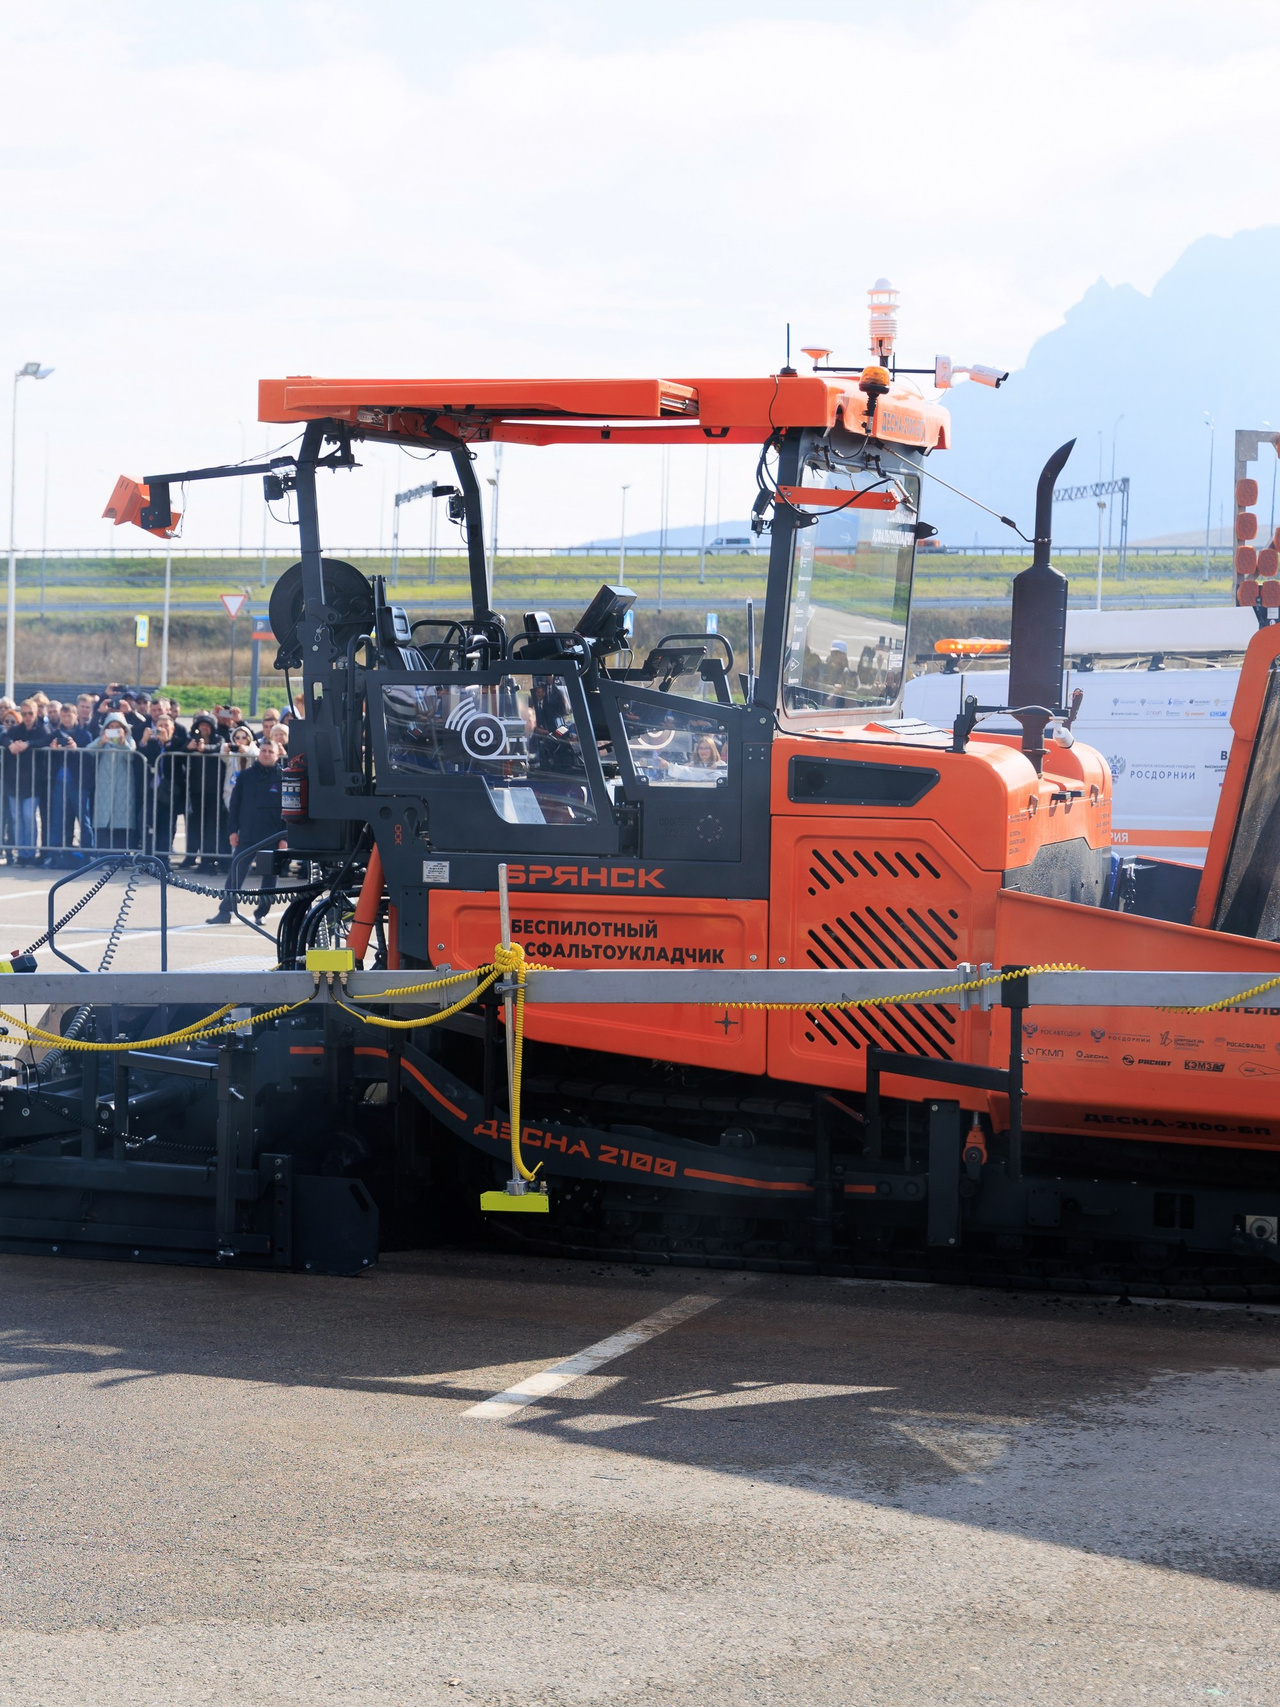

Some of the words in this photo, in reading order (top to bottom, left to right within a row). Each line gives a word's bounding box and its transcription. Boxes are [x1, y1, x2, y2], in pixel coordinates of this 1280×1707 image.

[1130, 770, 1196, 780] РОСДОРНИИ
[506, 864, 666, 889] БРЯНСК
[511, 918, 658, 939] БЕСПИЛОТНЫЙ
[520, 941, 725, 965] СФАЛЬТОУКЛАДЧИК
[1040, 1029, 1081, 1038] РОСАВТОДОР
[1035, 1048, 1064, 1057] ГКМП
[1226, 1041, 1266, 1049] РОСАСФАЛЬТ
[1083, 1113, 1271, 1136] ДЕСНА-2100-БП
[473, 1119, 591, 1159] ДЕСНА
[597, 1144, 677, 1178] 2100
